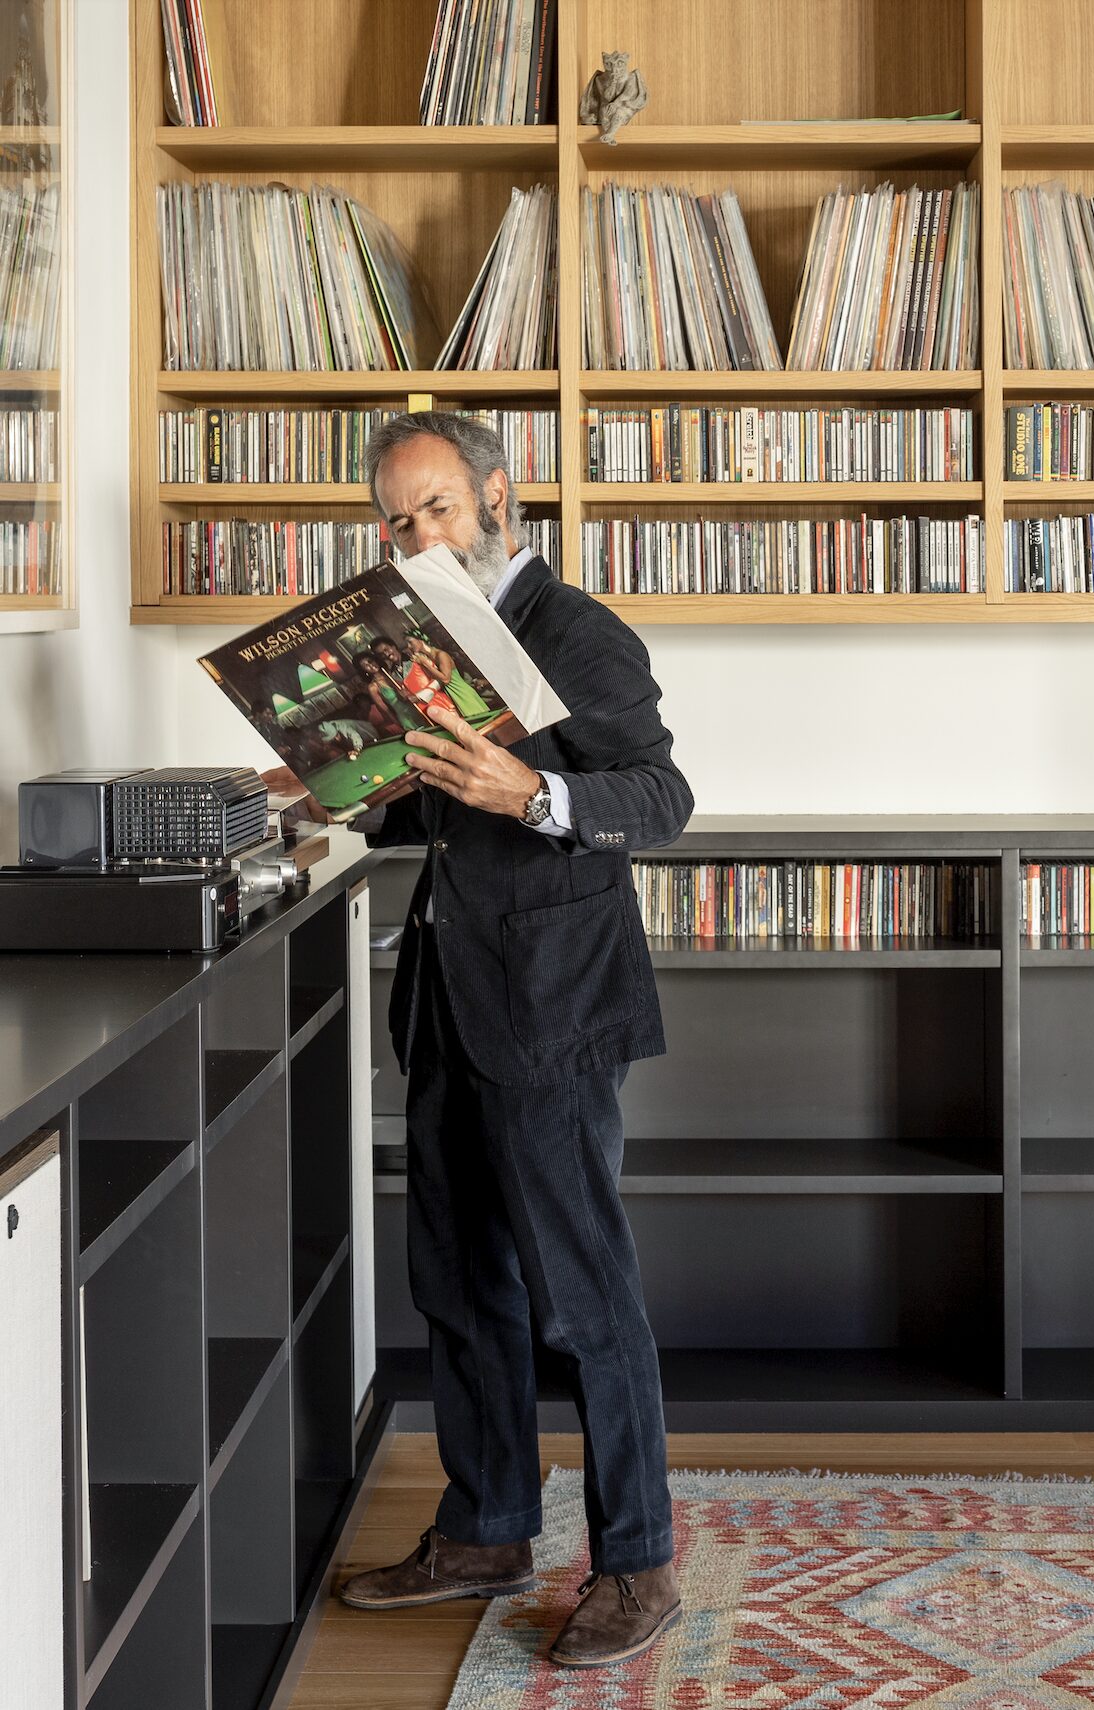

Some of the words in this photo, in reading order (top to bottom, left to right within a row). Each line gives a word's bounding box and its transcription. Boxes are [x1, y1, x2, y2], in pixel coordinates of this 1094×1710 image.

[746, 412, 754, 440] Scratch
[1016, 412, 1025, 452] STUDIO
[1016, 454, 1025, 476] ONE
[238, 624, 302, 663] WILSON
[301, 587, 371, 630] PICKETT
[265, 640, 298, 661] PICKETT
[298, 635, 308, 644] IN
[307, 627, 325, 640] THE
[324, 611, 354, 633] POCKET
[788, 885, 793, 893] OF
